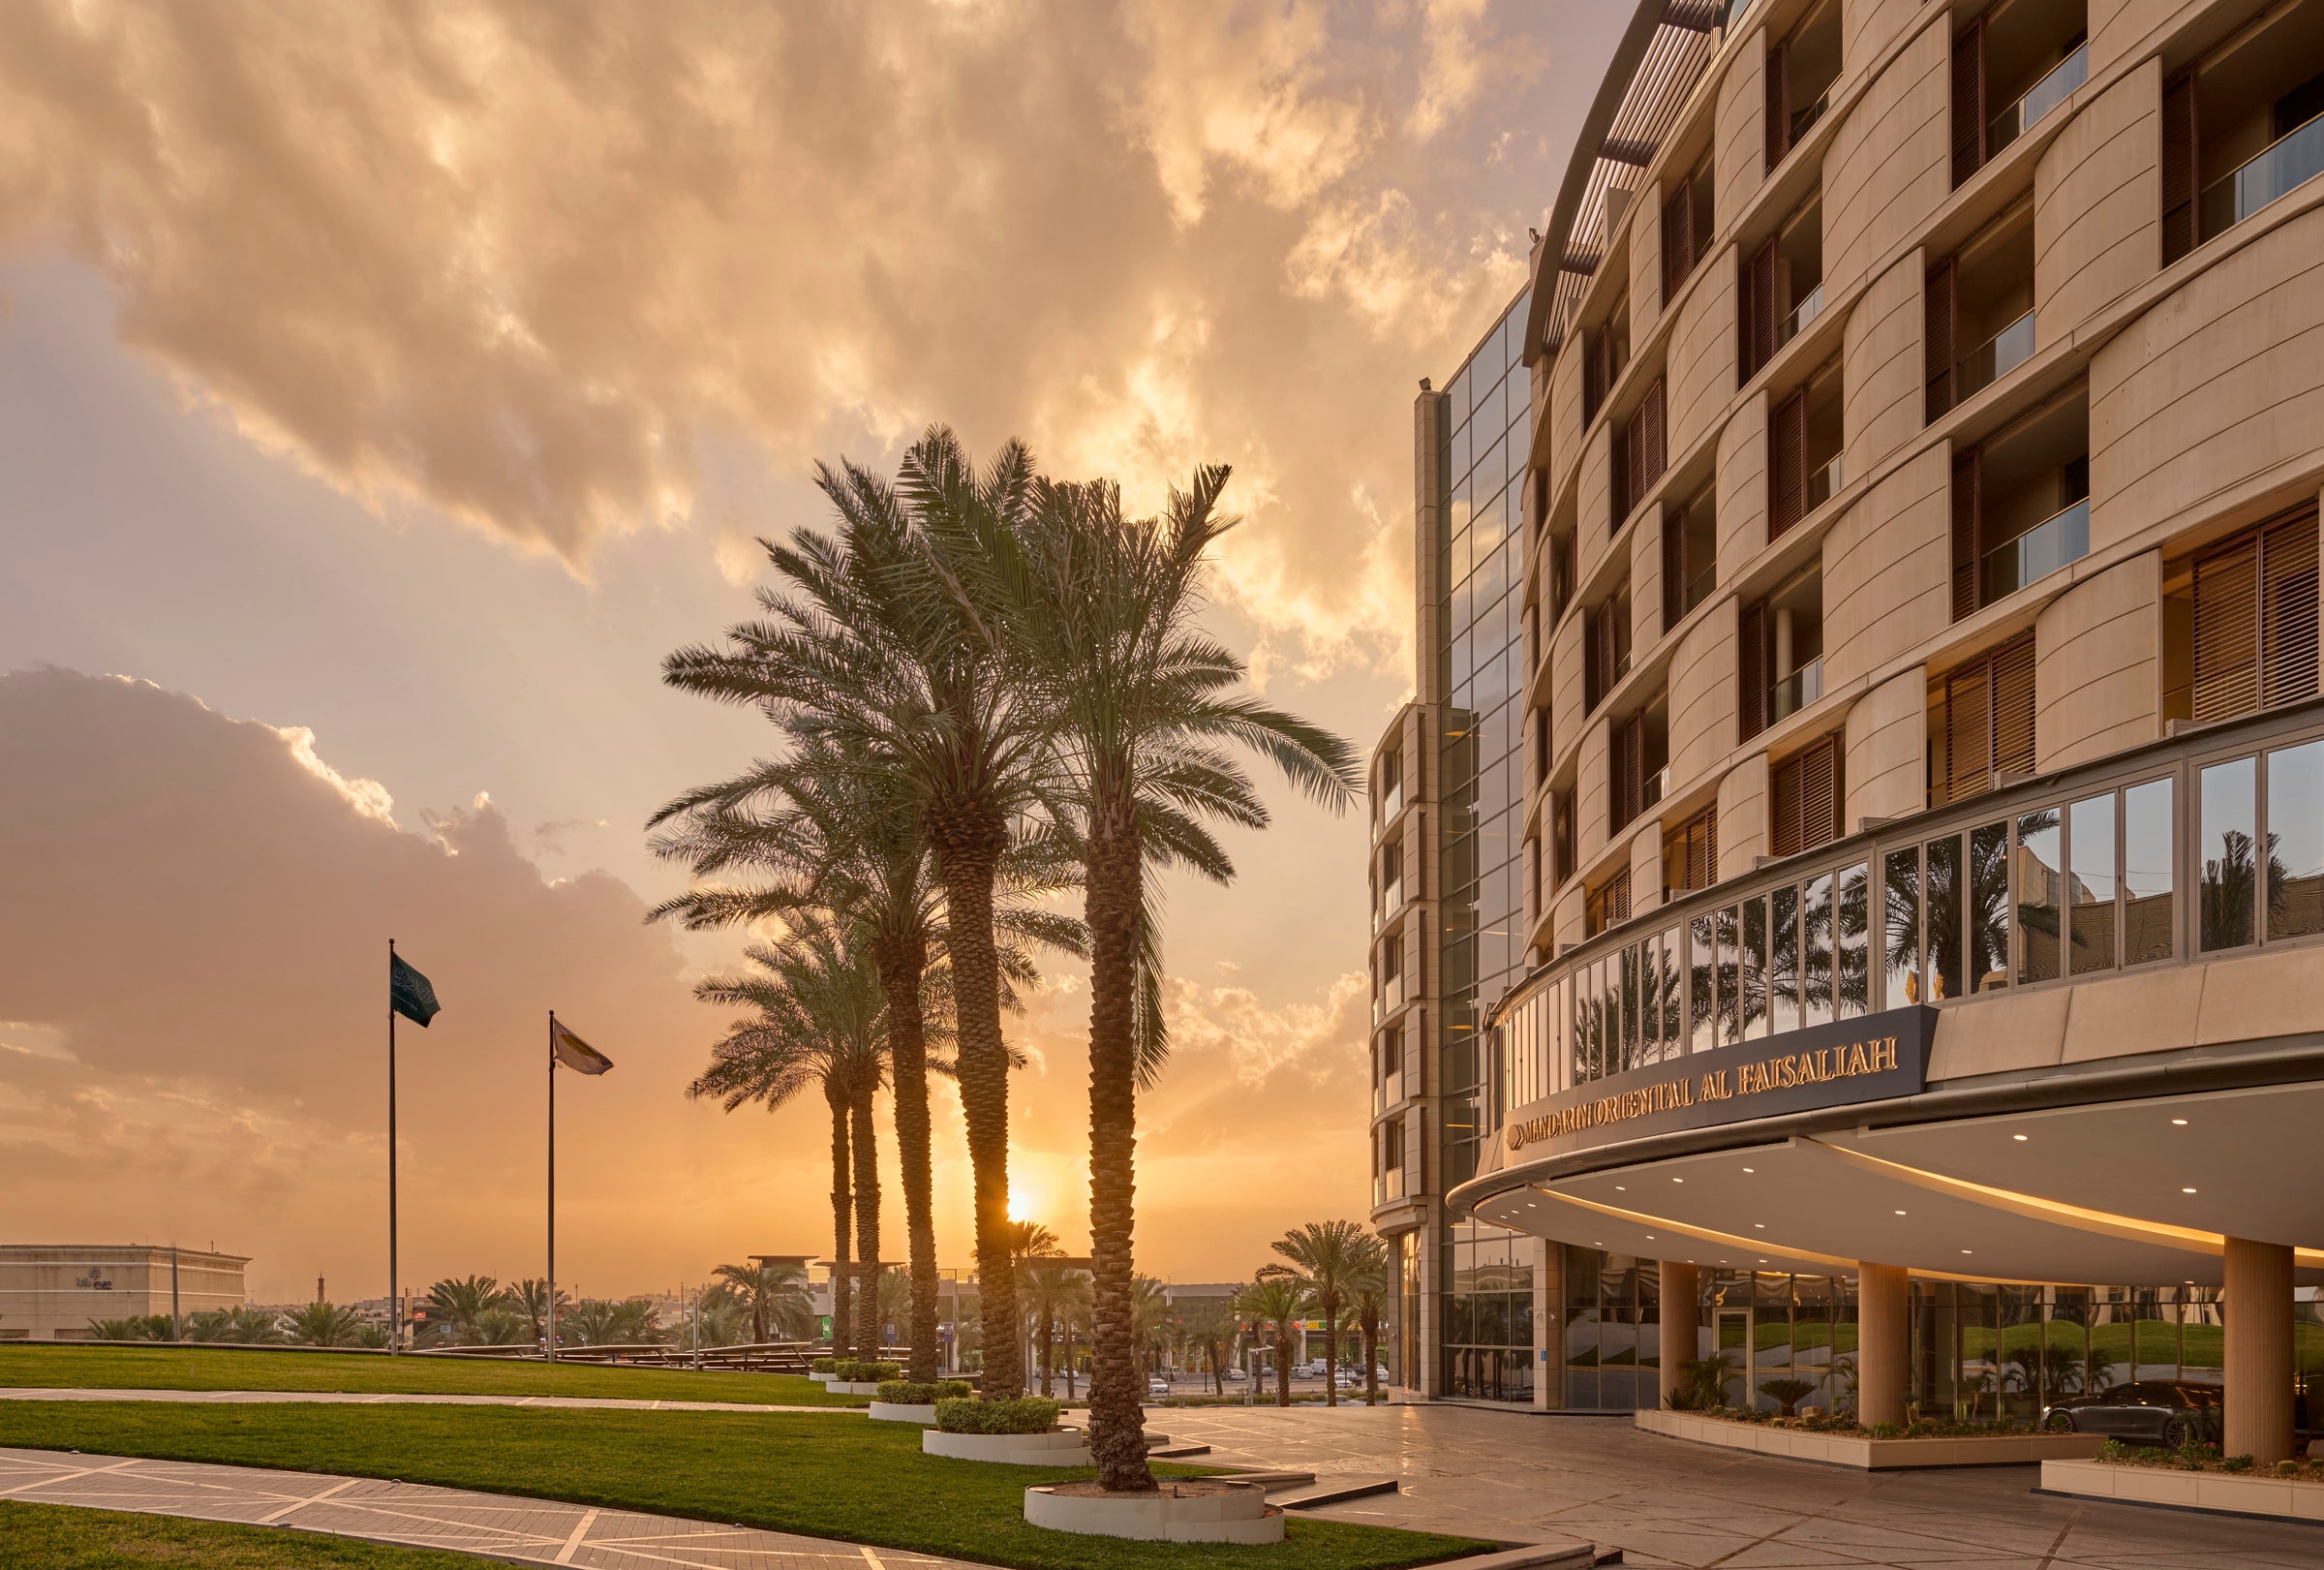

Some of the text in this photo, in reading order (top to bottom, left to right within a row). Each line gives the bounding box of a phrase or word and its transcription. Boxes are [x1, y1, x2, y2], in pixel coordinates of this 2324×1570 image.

[1525, 1036, 1898, 1143] MANDARIN ORIENTAL AL FAISALIAH
